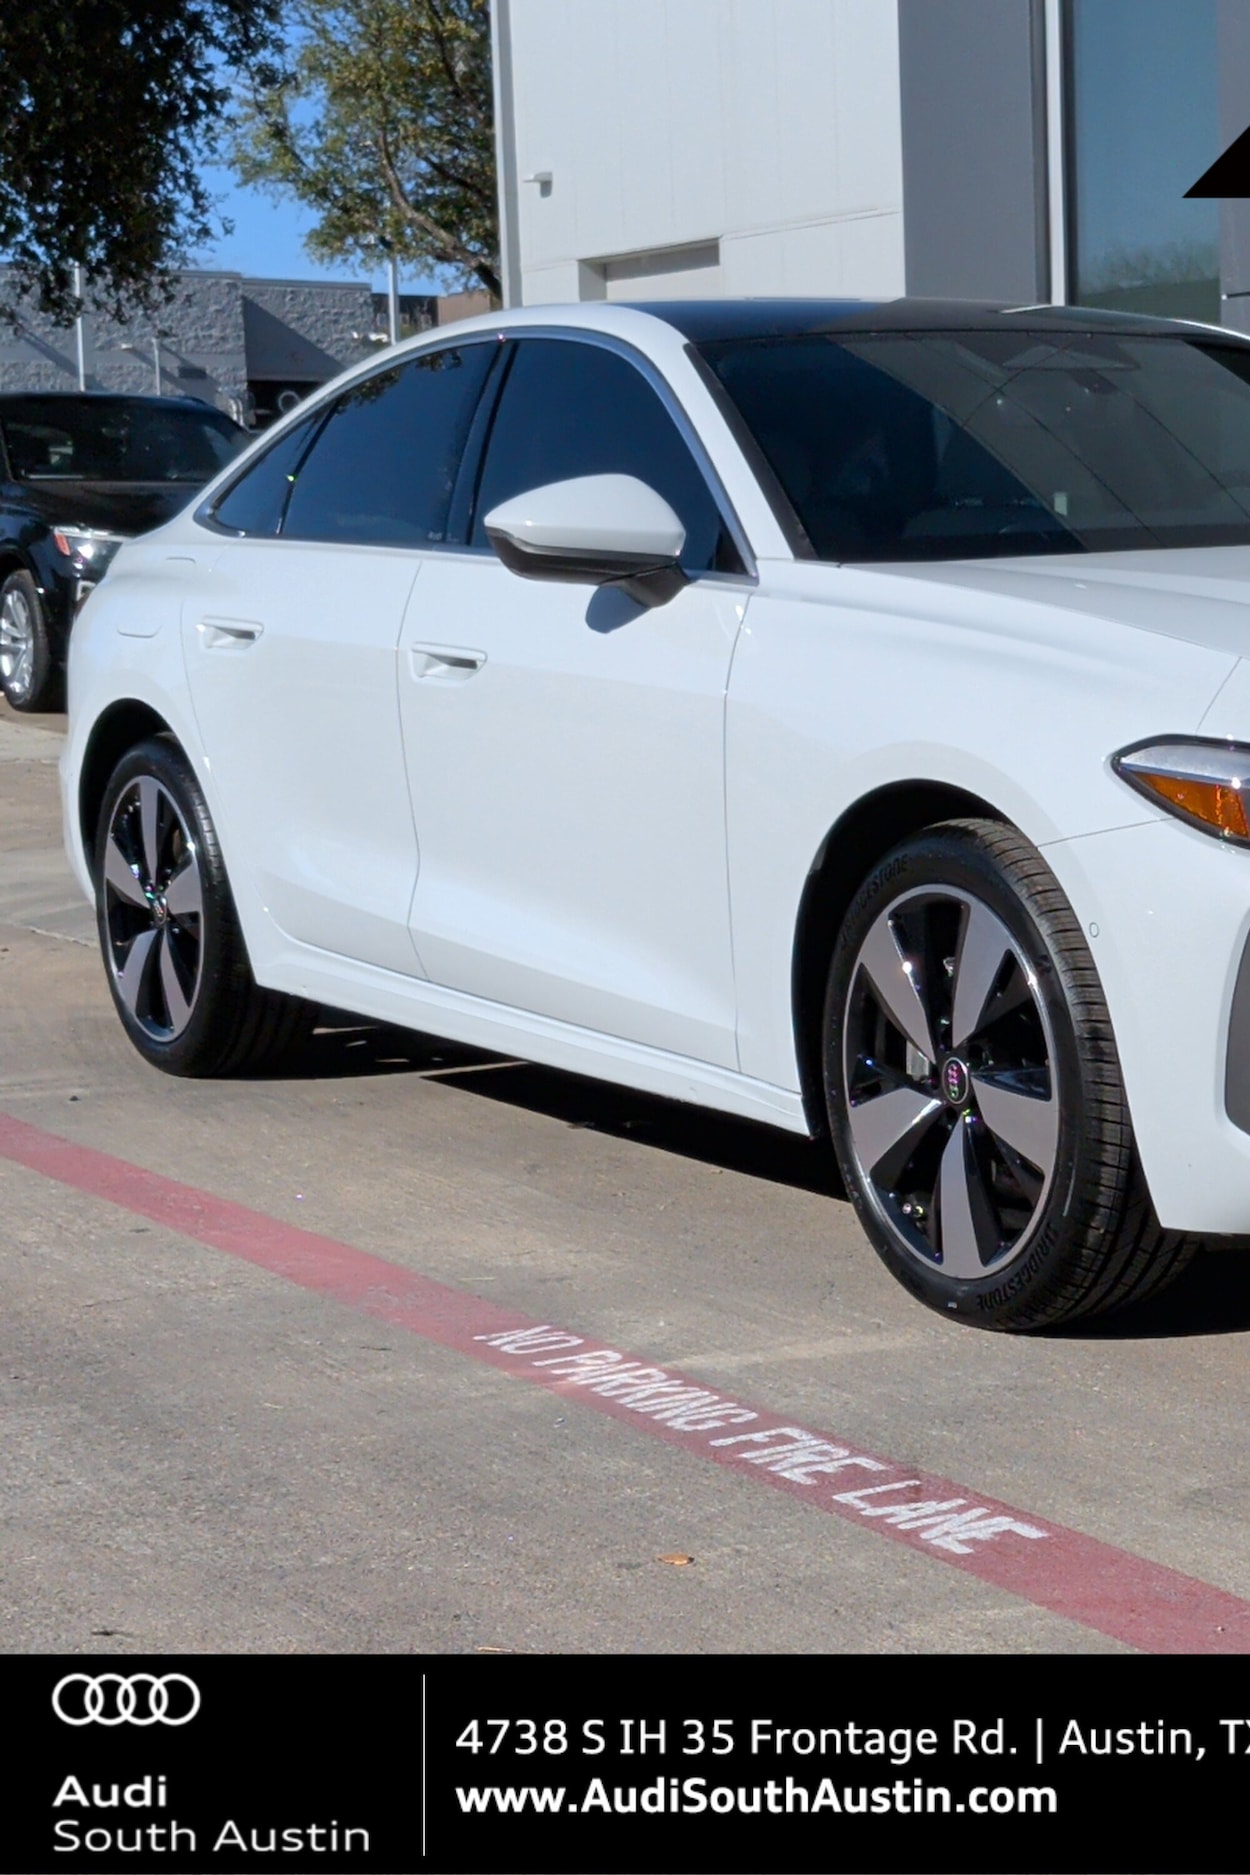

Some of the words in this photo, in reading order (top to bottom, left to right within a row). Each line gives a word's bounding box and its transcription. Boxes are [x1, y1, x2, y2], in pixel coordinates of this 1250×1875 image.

[472, 1325, 584, 1354] NO
[532, 1350, 758, 1431] PARKING
[709, 1427, 892, 1485] FIRE
[832, 1480, 1049, 1554] LANE
